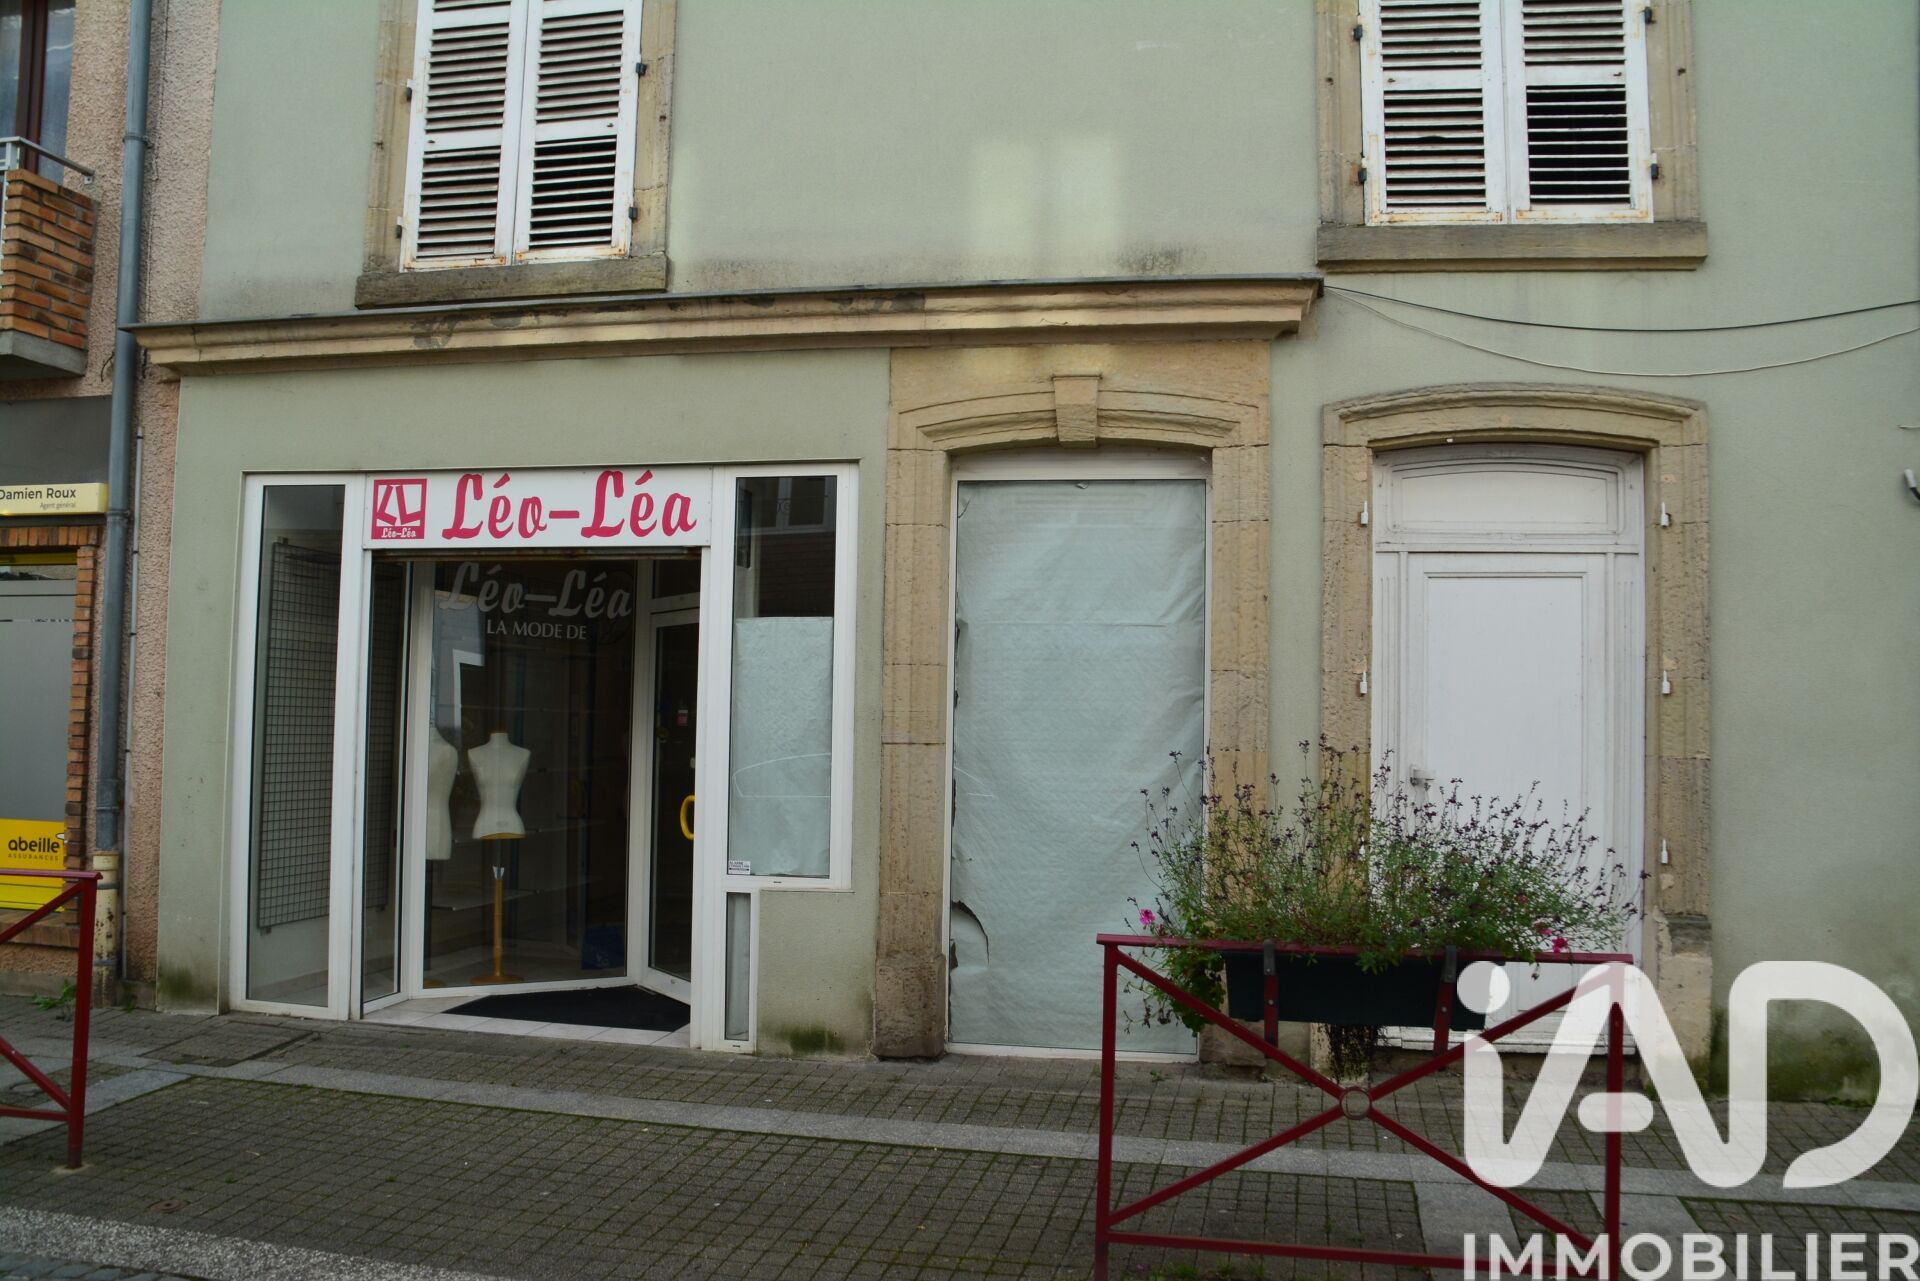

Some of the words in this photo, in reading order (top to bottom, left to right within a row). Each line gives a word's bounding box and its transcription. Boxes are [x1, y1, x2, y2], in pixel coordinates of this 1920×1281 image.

[46, 487, 76, 498] Roux
[441, 470, 697, 540] Léo-Léa
[381, 528, 416, 538] Léo-Léa
[439, 562, 632, 619] Léo-Léa
[487, 619, 507, 635] LA
[512, 621, 562, 639] MODE
[566, 625, 587, 640] DE
[8, 836, 60, 853] abeille
